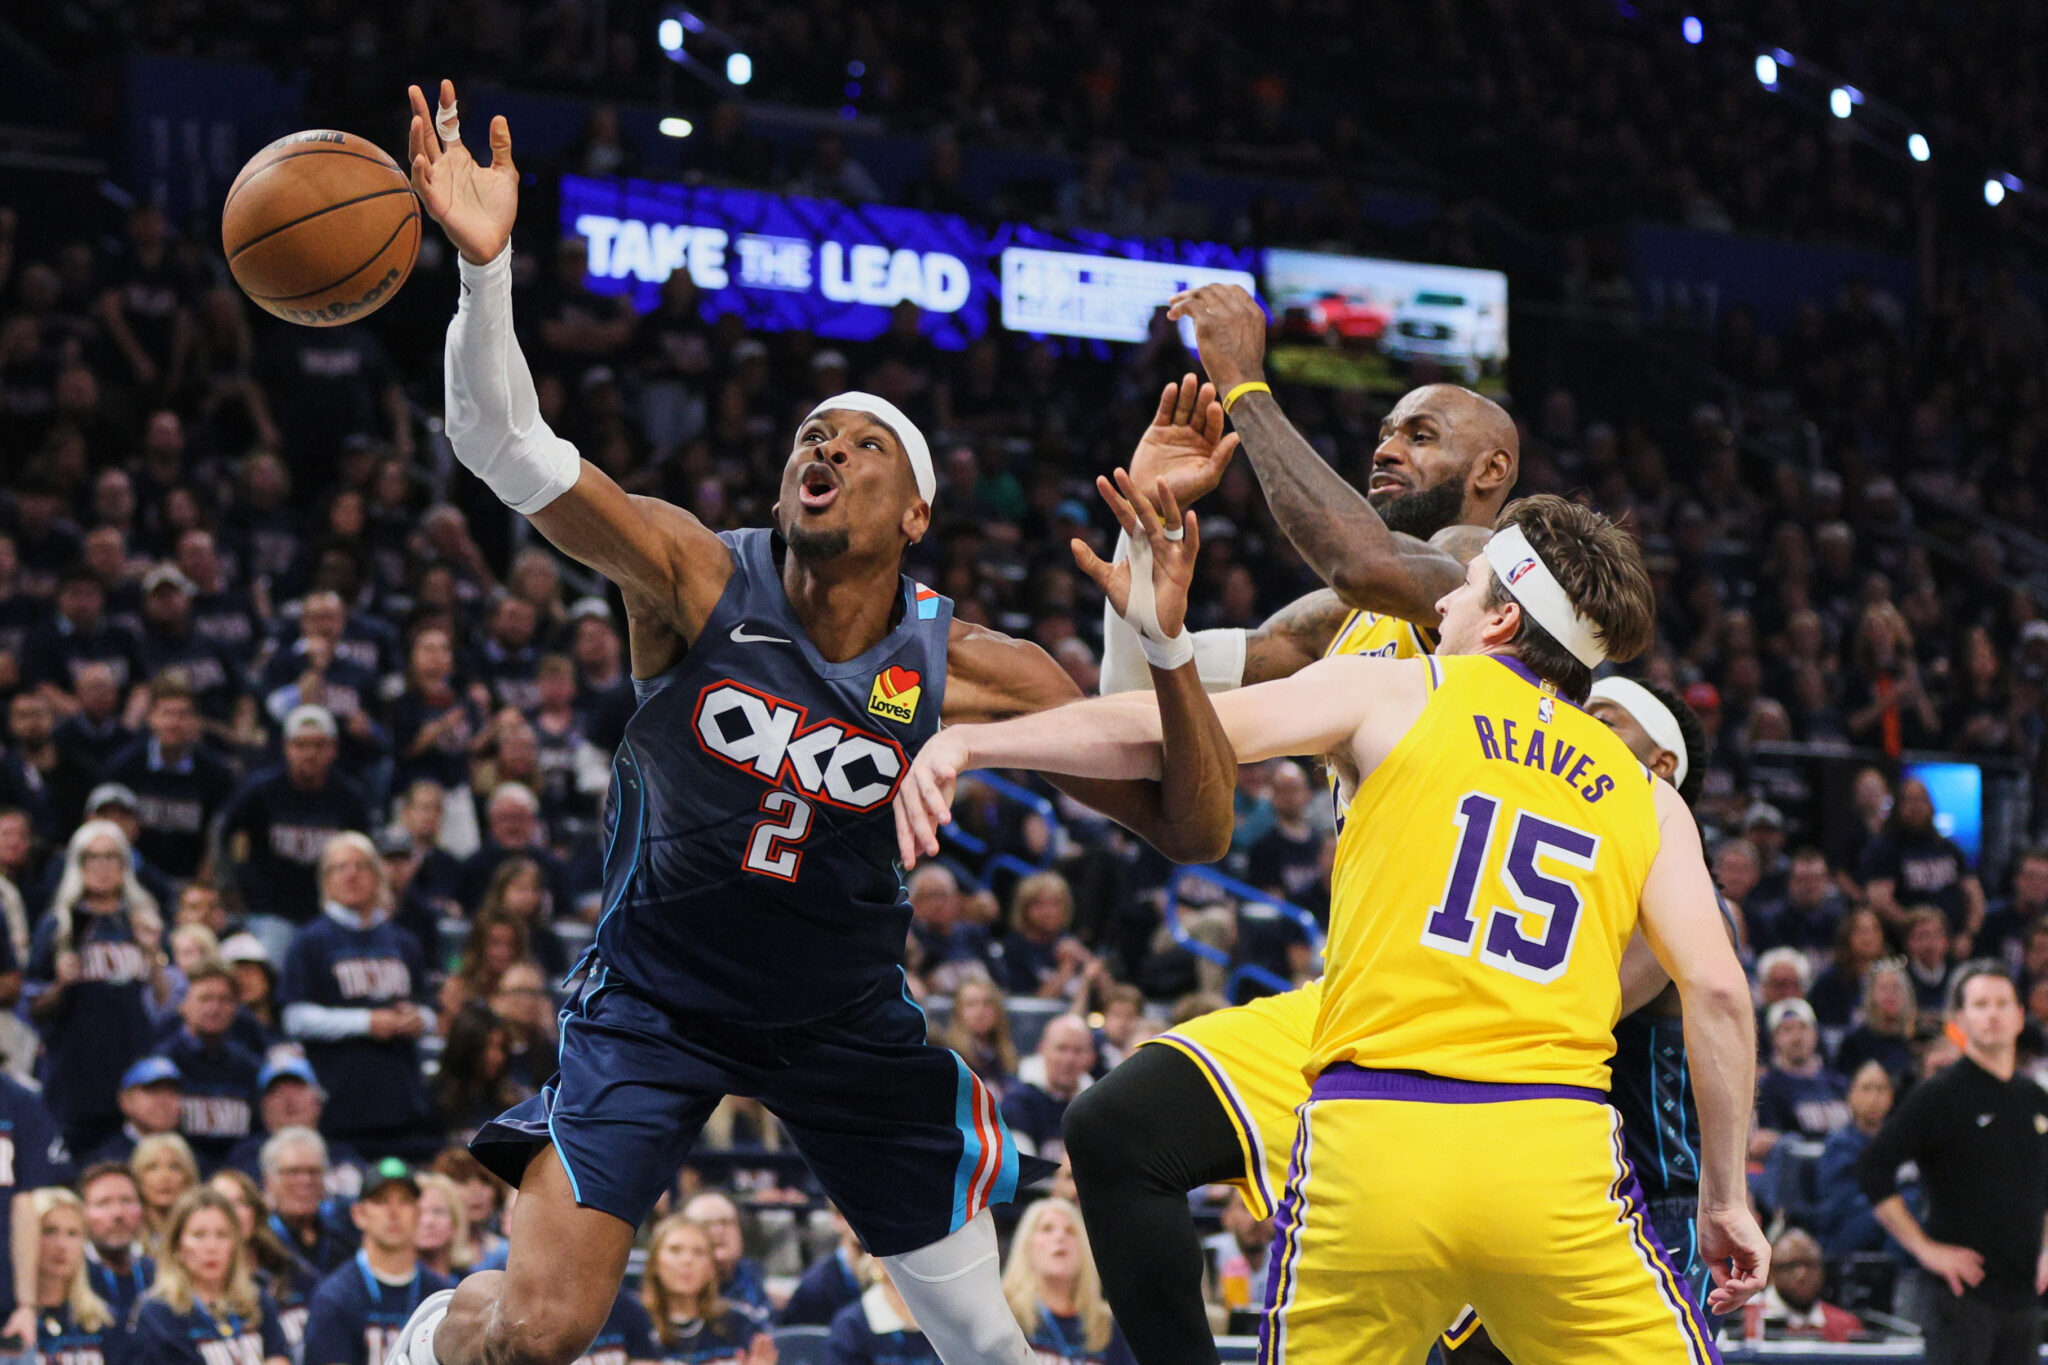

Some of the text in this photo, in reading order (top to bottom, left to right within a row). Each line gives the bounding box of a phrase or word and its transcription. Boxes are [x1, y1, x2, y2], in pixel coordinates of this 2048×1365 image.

[576, 213, 729, 290] TAKE
[736, 235, 812, 289] THE
[820, 240, 971, 313] LEAD
[697, 684, 903, 809] OKC
[1473, 715, 1615, 803] REAVES
[744, 790, 813, 880] 2
[1422, 791, 1599, 981] 15
